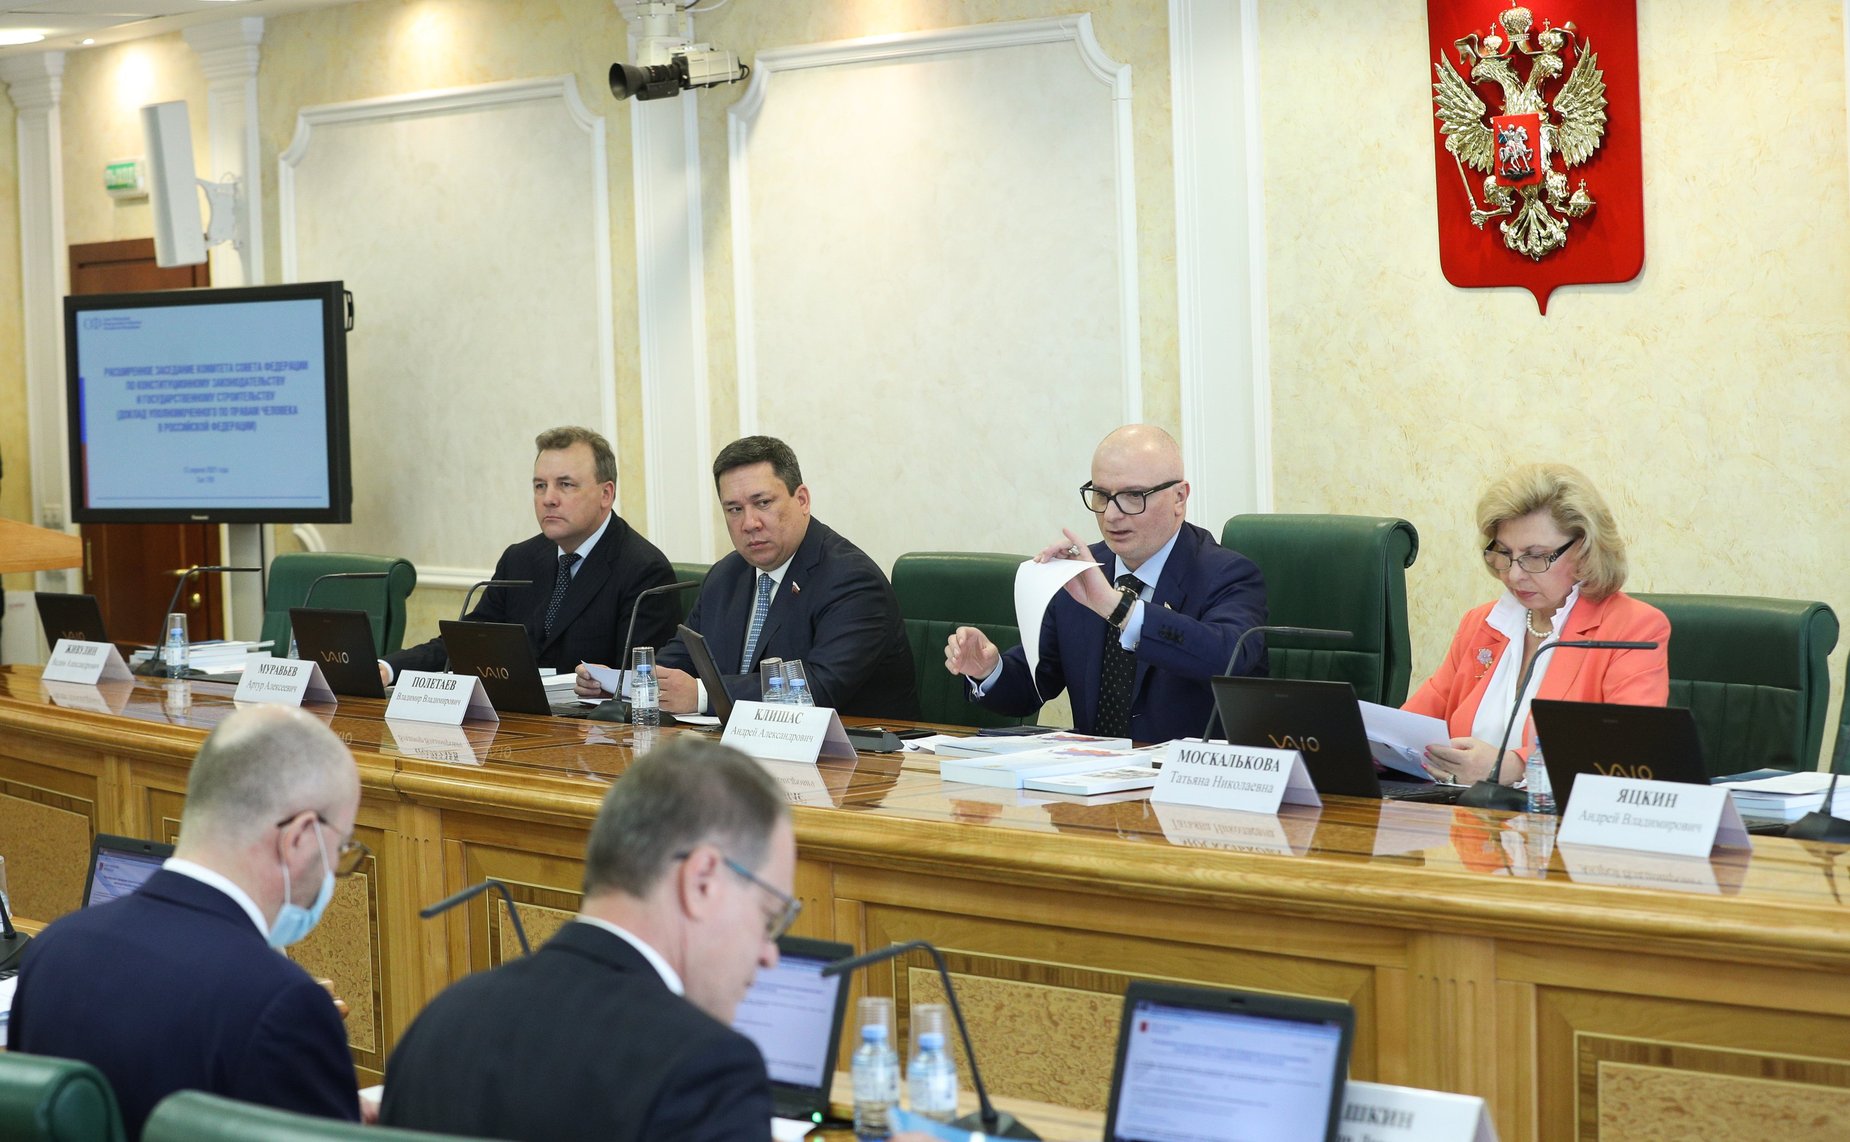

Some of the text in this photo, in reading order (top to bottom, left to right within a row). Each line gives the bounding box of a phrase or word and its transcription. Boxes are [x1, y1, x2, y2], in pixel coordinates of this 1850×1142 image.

[320, 650, 350, 664] VAIO
[258, 663, 299, 677] МУРАВЬЕВ
[476, 665, 509, 680] VAIO
[411, 676, 457, 691] ПОЛЕТАЕВ
[754, 708, 804, 724] КЛИШАС
[730, 726, 814, 743] Андрей Александрович
[1267, 734, 1320, 752] VAIO
[1177, 749, 1281, 773] МОСКАЛЬКОВА
[1170, 770, 1275, 794] Татьяна Николаевна
[1616, 788, 1679, 808] ЯЦКИН
[1578, 809, 1620, 826] Андрей
[1341, 1102, 1415, 1130] ШКИН
